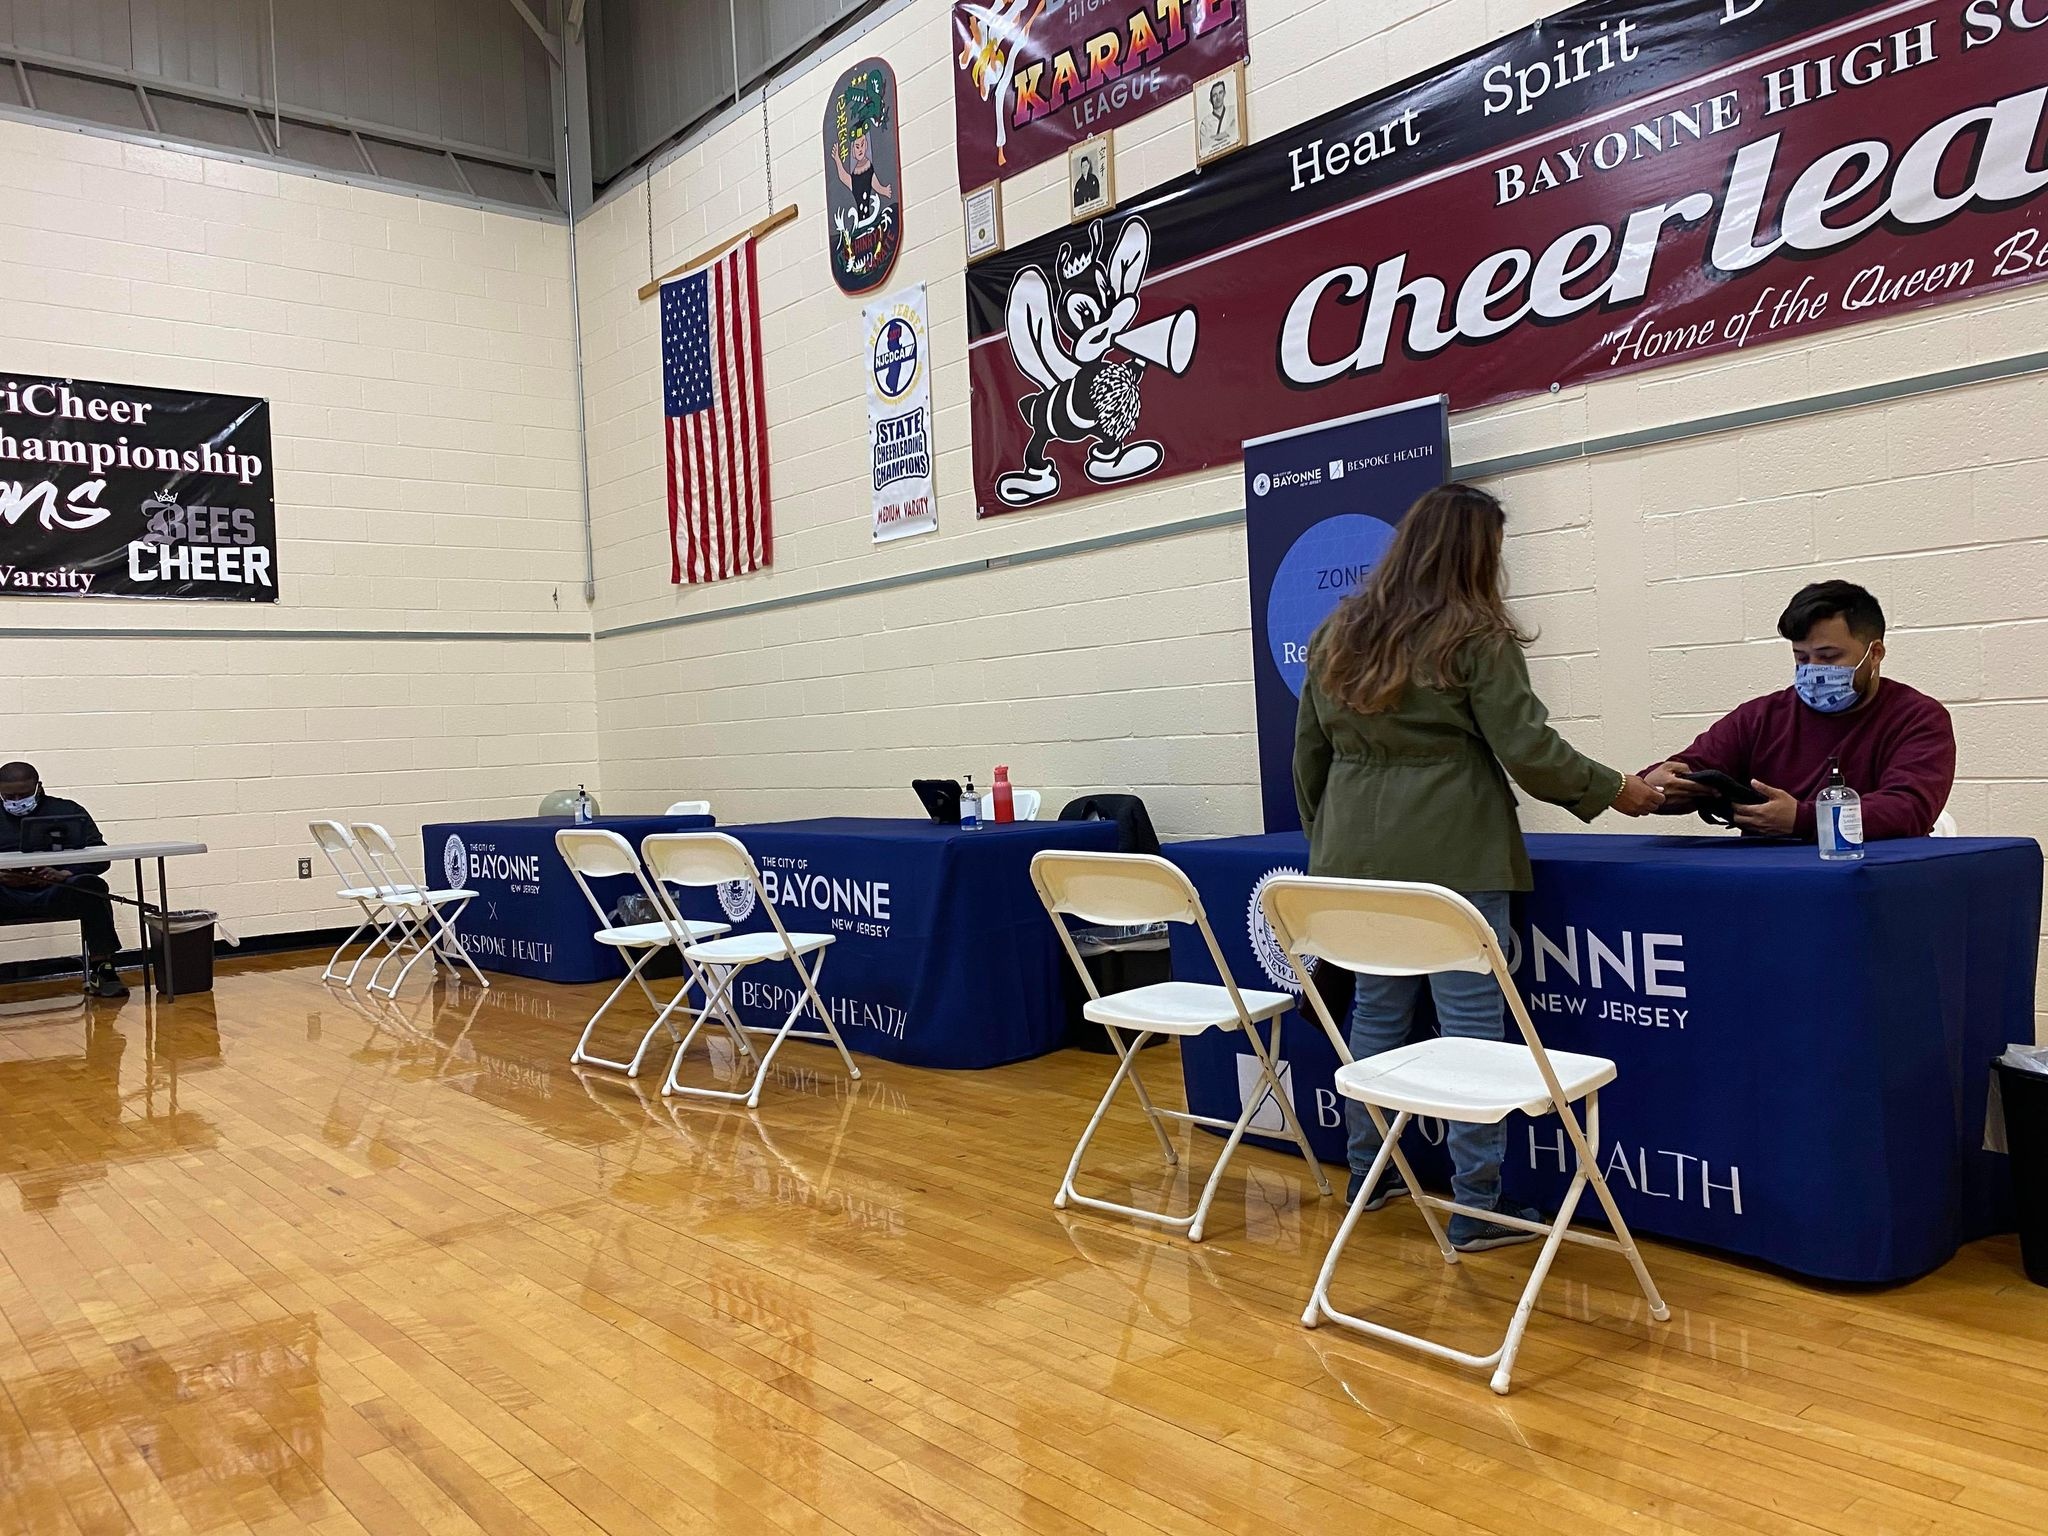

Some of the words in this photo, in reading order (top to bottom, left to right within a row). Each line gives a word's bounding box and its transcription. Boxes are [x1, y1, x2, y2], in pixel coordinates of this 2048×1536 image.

[1012, 0, 1235, 127] KARATE
[1072, 67, 1162, 130] LEAGUE
[1288, 108, 1421, 192] Heart
[1483, 17, 1640, 117] Spirit
[1495, 89, 1742, 206] BAYONNE
[1765, 20, 1939, 118] HIGH
[1724, 287, 1776, 347] of
[1769, 275, 1829, 329] the
[1841, 255, 1975, 311] Queen
[880, 411, 921, 443] STATE
[877, 434, 923, 465] CHEERLEADING
[1347, 454, 1390, 472] BESPOKE
[1393, 445, 1433, 462] HEALTH
[876, 455, 927, 487] CHAMPIONS
[1273, 468, 1322, 489] BAYONNE
[141, 499, 256, 546] BEES
[877, 504, 900, 524] MEDIUM
[903, 497, 929, 518] VARSITY
[128, 541, 273, 587] CHEER
[470, 854, 540, 882] BAYONNE
[762, 856, 777, 867] THE
[778, 857, 795, 869] CITY
[798, 859, 808, 869] OF
[762, 870, 891, 920] BAYONNE
[831, 918, 853, 931] NEW
[856, 922, 891, 938] JERSEY
[461, 933, 507, 957] BESPOKE
[512, 939, 553, 963] HEALTH
[1266, 952, 1288, 976] NEW
[832, 996, 908, 1040] HEALTH
[1530, 992, 1587, 1016] NEW
[1599, 1001, 1689, 1030] JERSEY
[1528, 1125, 1743, 1215] HALTH
